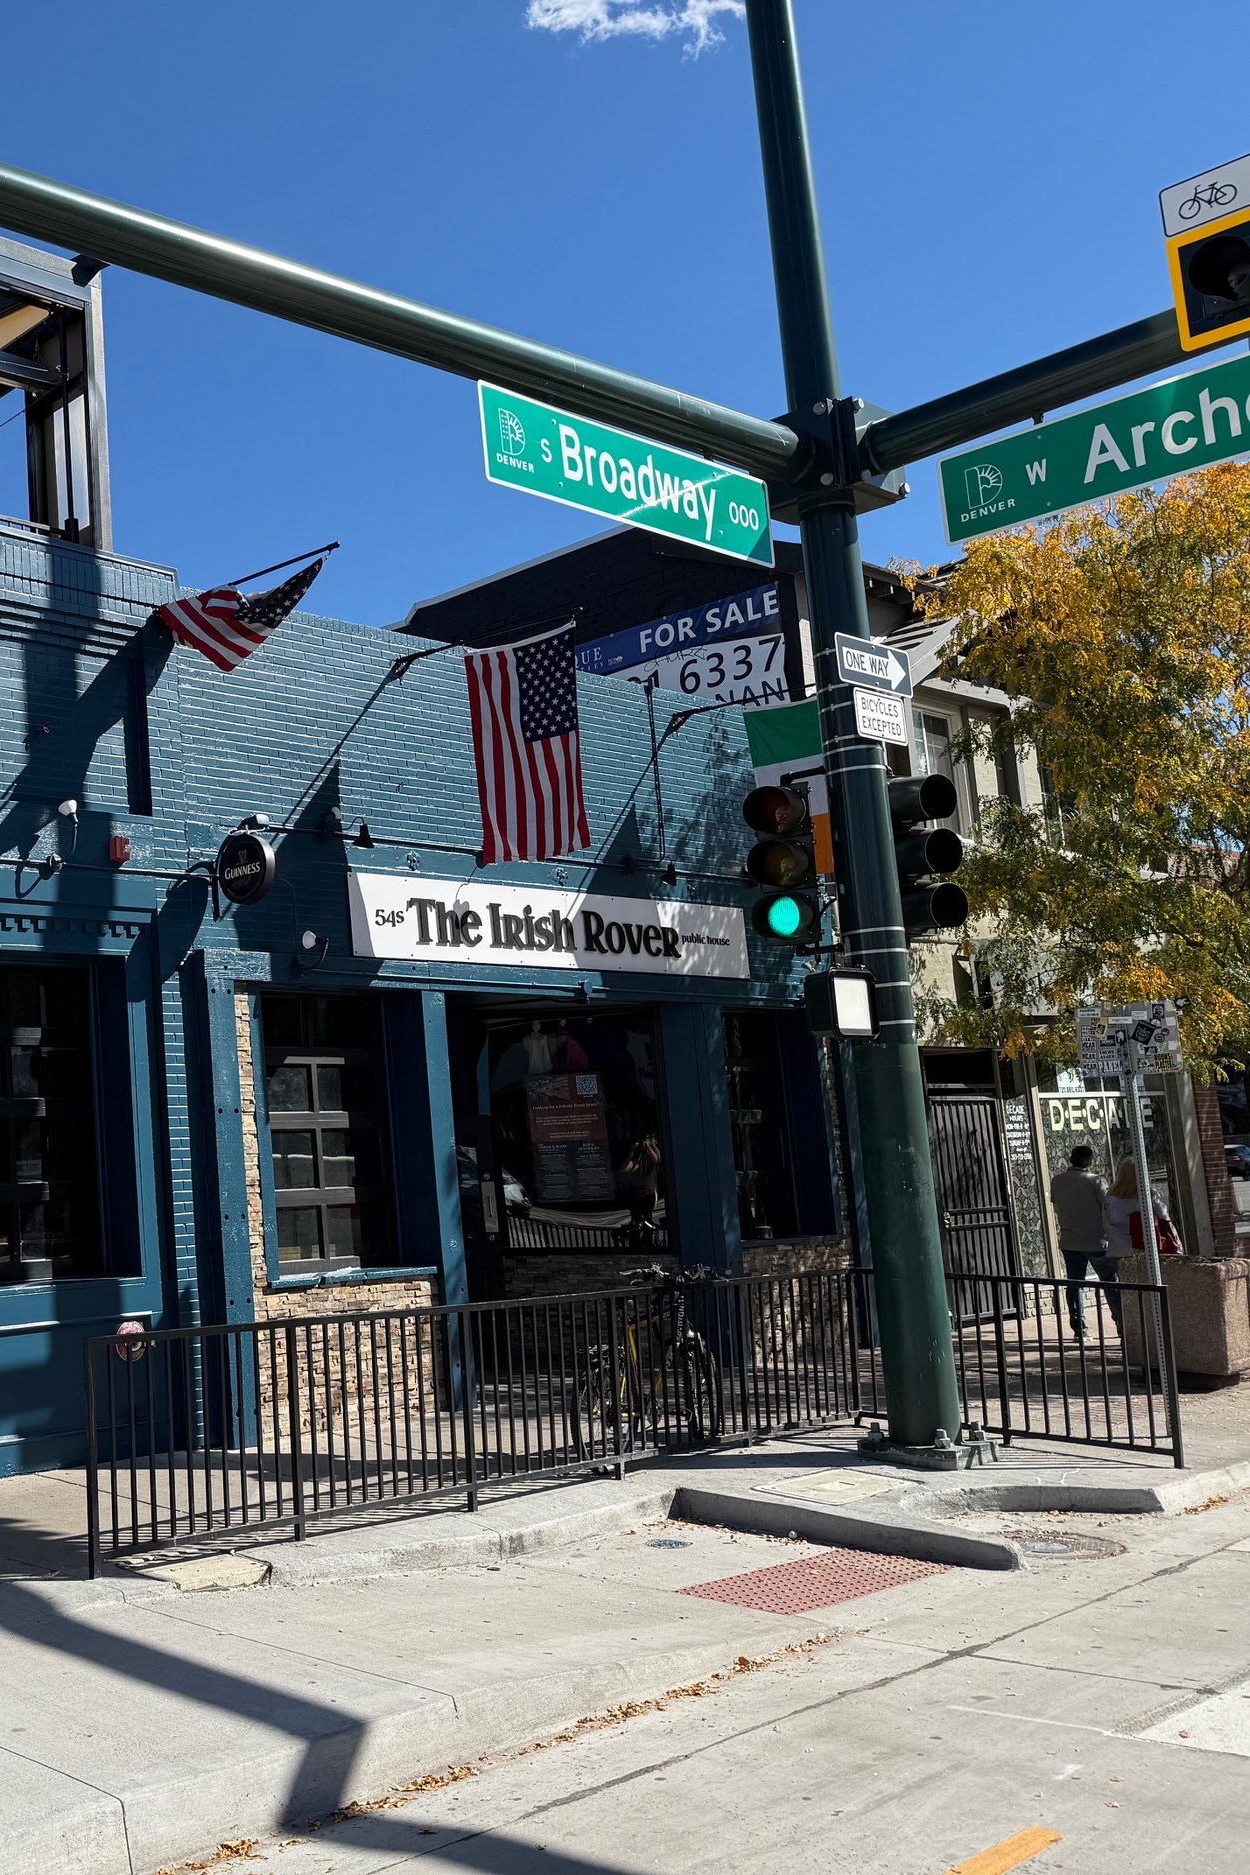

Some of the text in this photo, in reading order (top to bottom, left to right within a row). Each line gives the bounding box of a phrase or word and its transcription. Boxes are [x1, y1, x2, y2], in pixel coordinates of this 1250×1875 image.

[1025, 387, 1250, 486] W Arch
[496, 451, 535, 474] DENVER
[541, 438, 552, 463] S
[558, 423, 716, 542] Broadway
[960, 498, 1016, 523] DENVER
[639, 589, 780, 654] FOR SALE
[680, 636, 783, 694] 6337
[845, 650, 889, 677] ONE WAY
[861, 697, 899, 718] BICYCLES
[862, 716, 902, 736] EXCEPTED
[224, 861, 261, 880] GUINNESS
[406, 897, 483, 947] The
[681, 933, 707, 945] public
[707, 935, 731, 946] house
